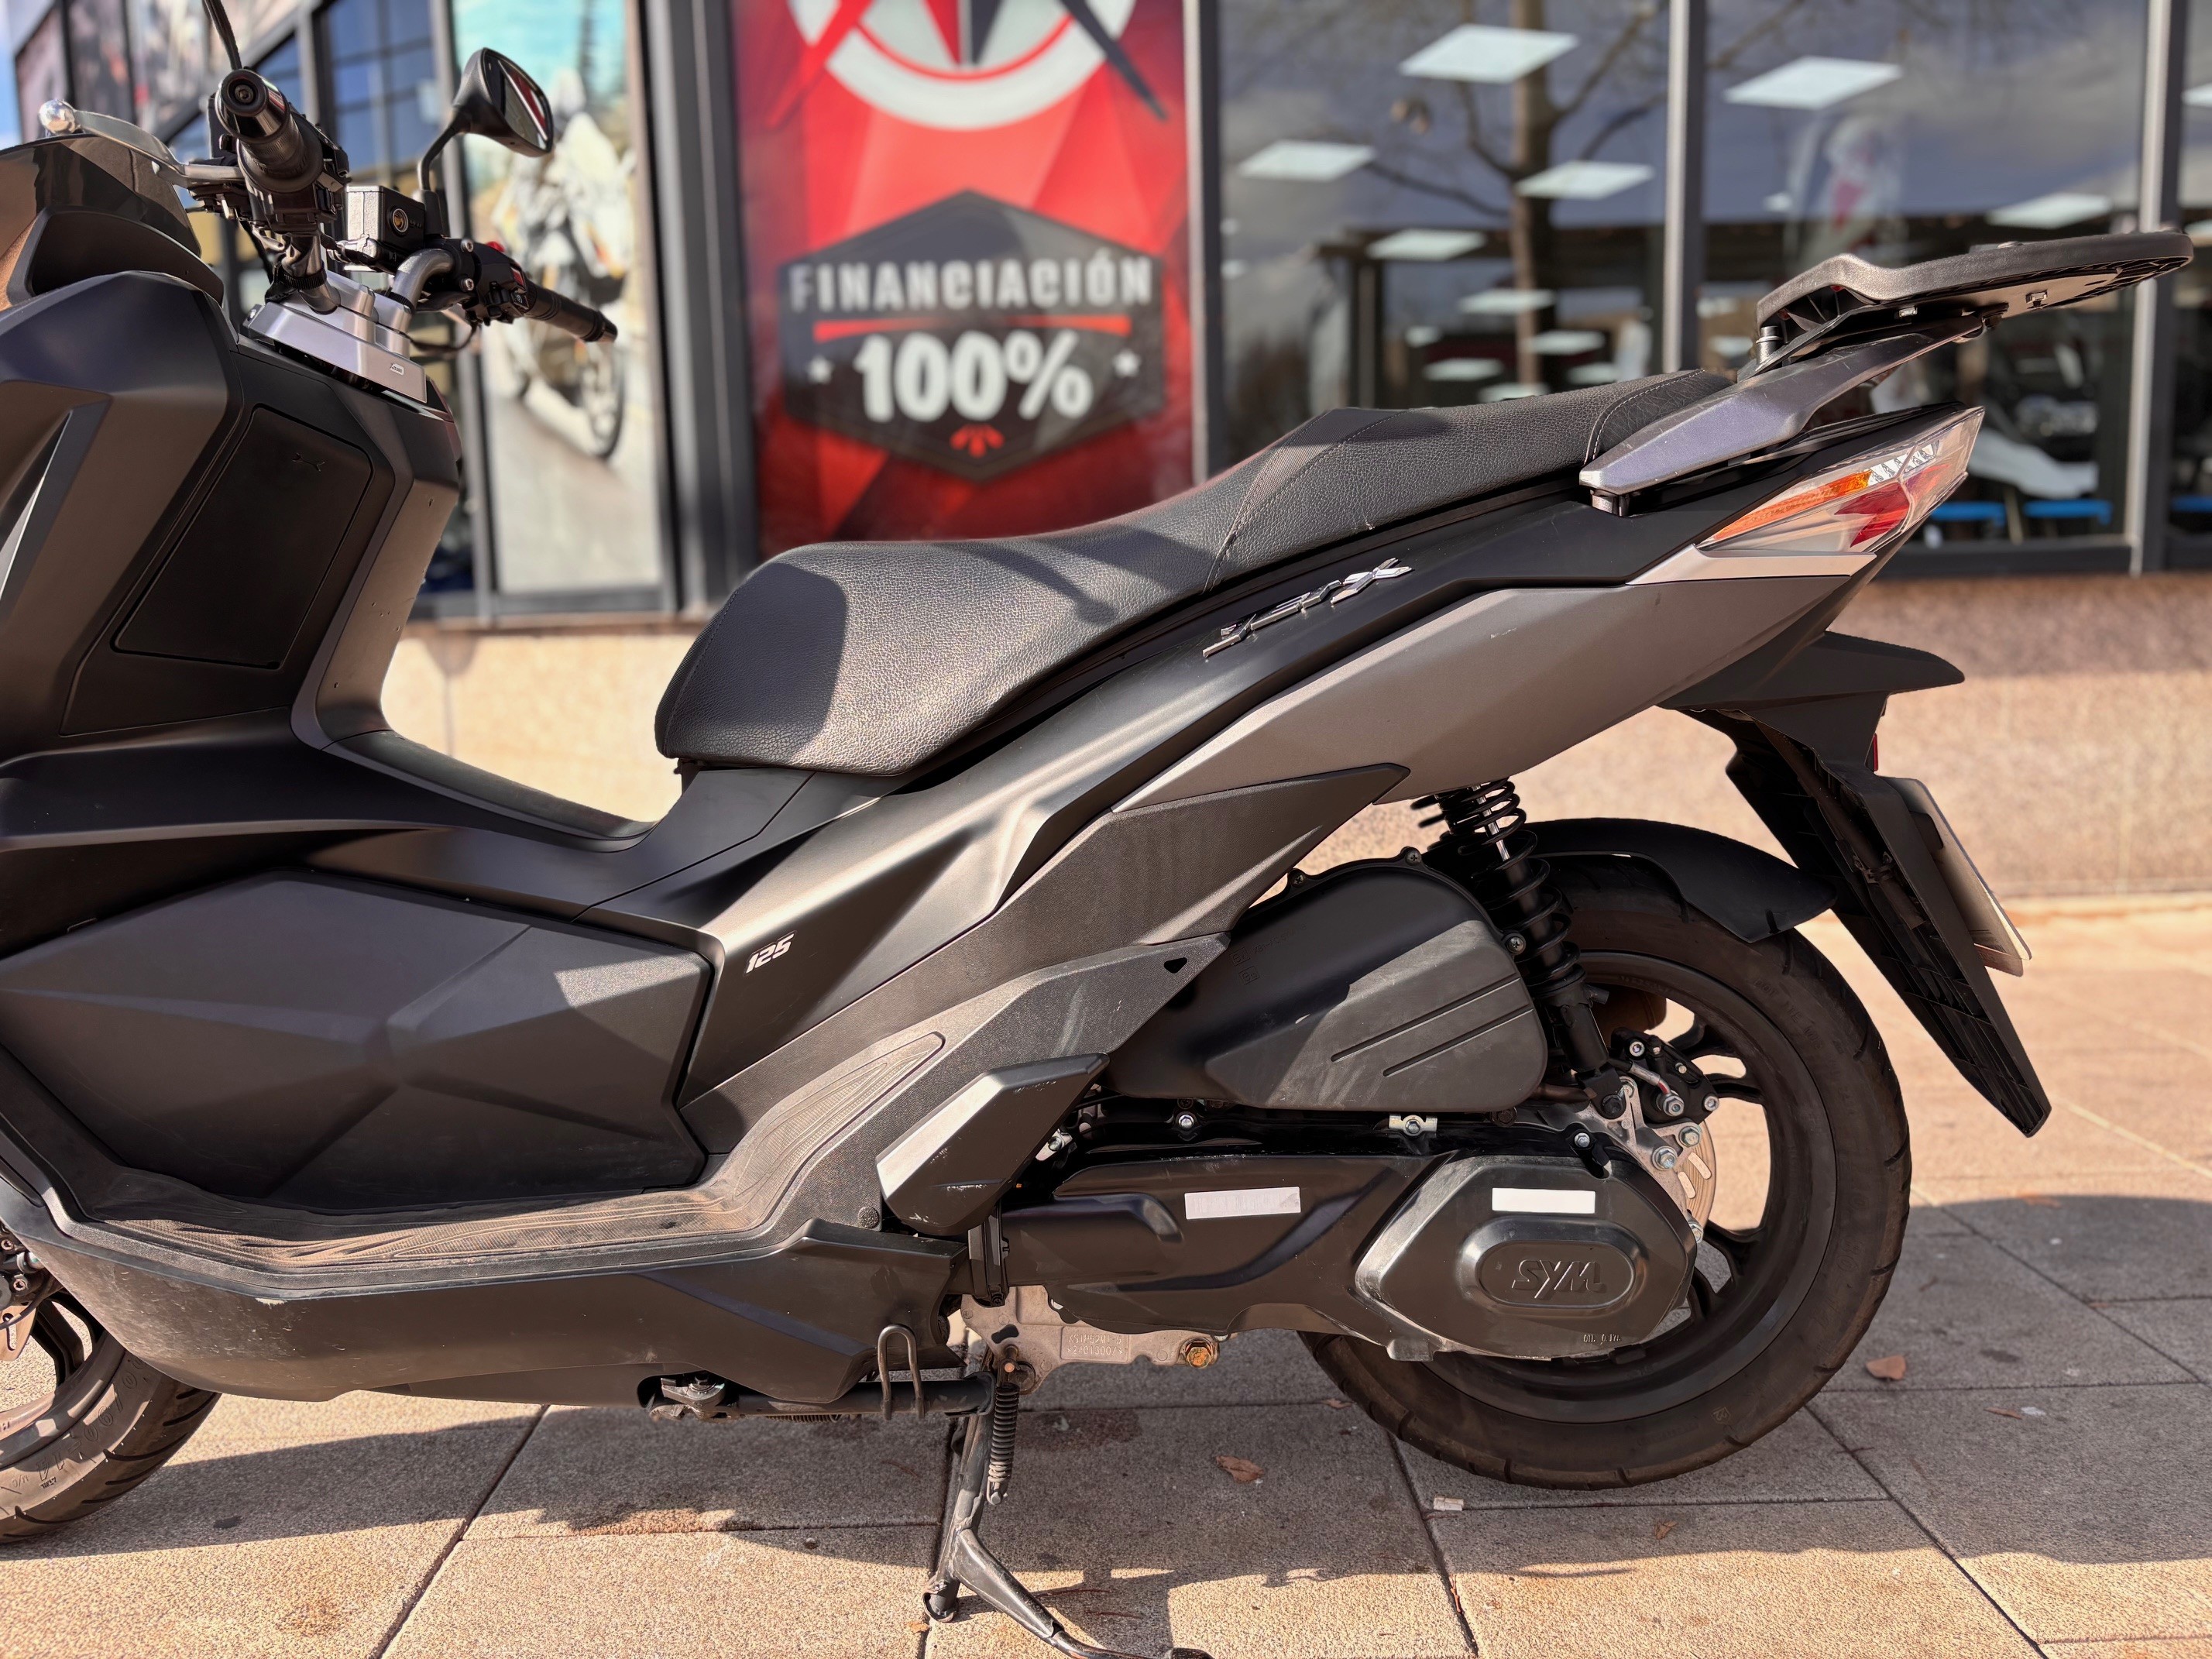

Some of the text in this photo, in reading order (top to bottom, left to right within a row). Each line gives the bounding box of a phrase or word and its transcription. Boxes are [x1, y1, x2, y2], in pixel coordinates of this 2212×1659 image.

[788, 247, 1152, 311] FINANCIACIÓN
[854, 330, 1094, 422] 100%
[746, 933, 795, 974] 125
[1512, 1259, 1605, 1299] SYM
